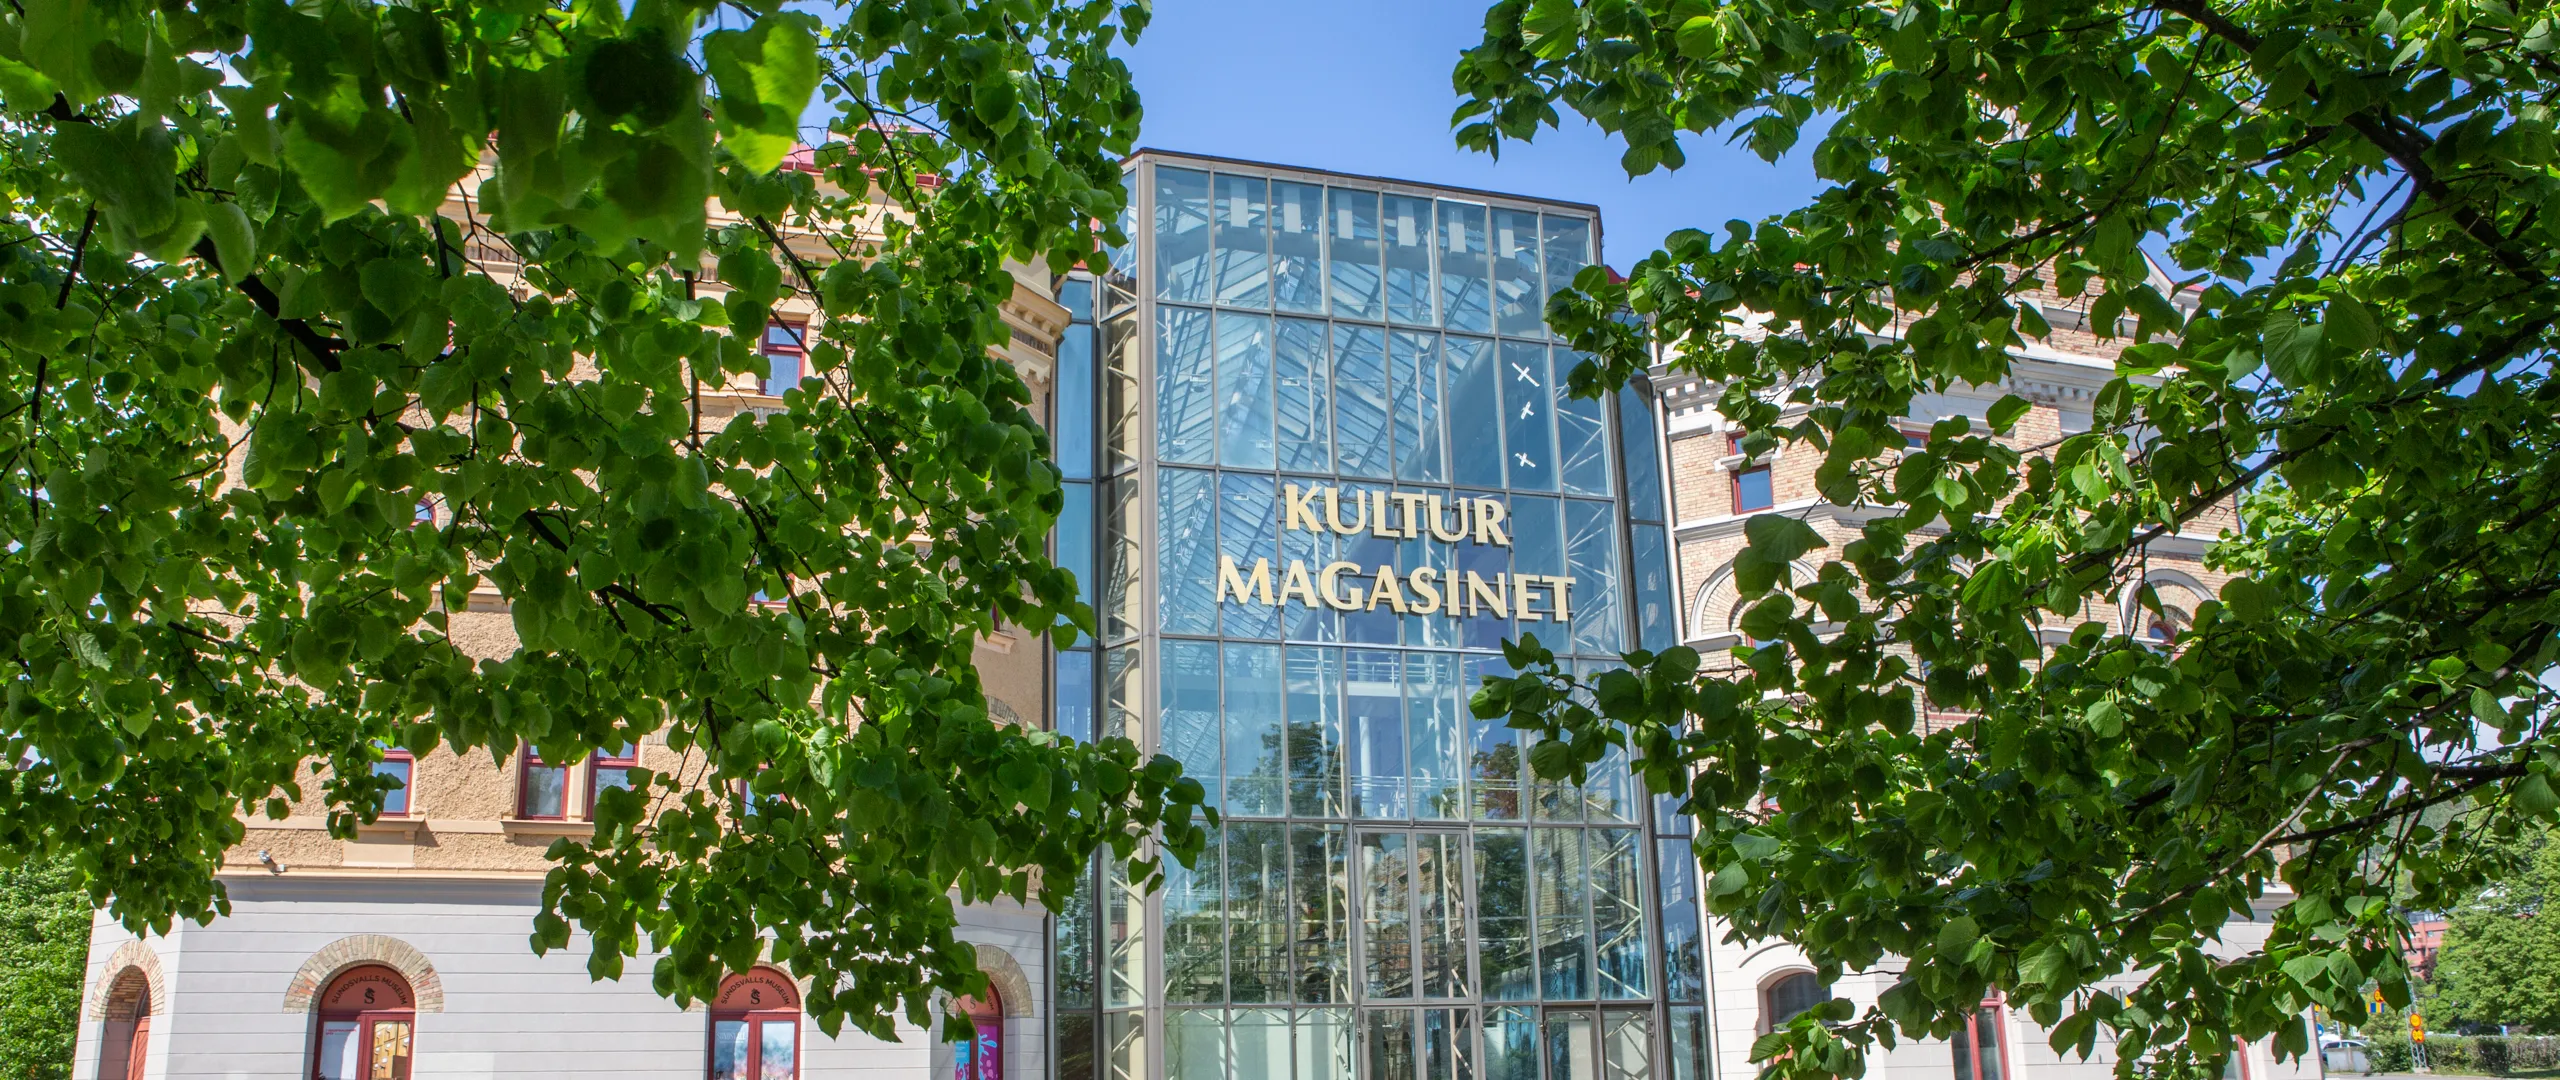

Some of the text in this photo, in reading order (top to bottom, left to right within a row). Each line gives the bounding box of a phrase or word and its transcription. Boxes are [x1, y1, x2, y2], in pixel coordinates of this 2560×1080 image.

[1284, 484, 1511, 546] KULTUR
[1216, 555, 1577, 622] MAGASINET
[331, 975, 408, 1005] SUNDSVALLS MUSEUM
[721, 977, 791, 1006] SUNDSVALLS MUSEUM
